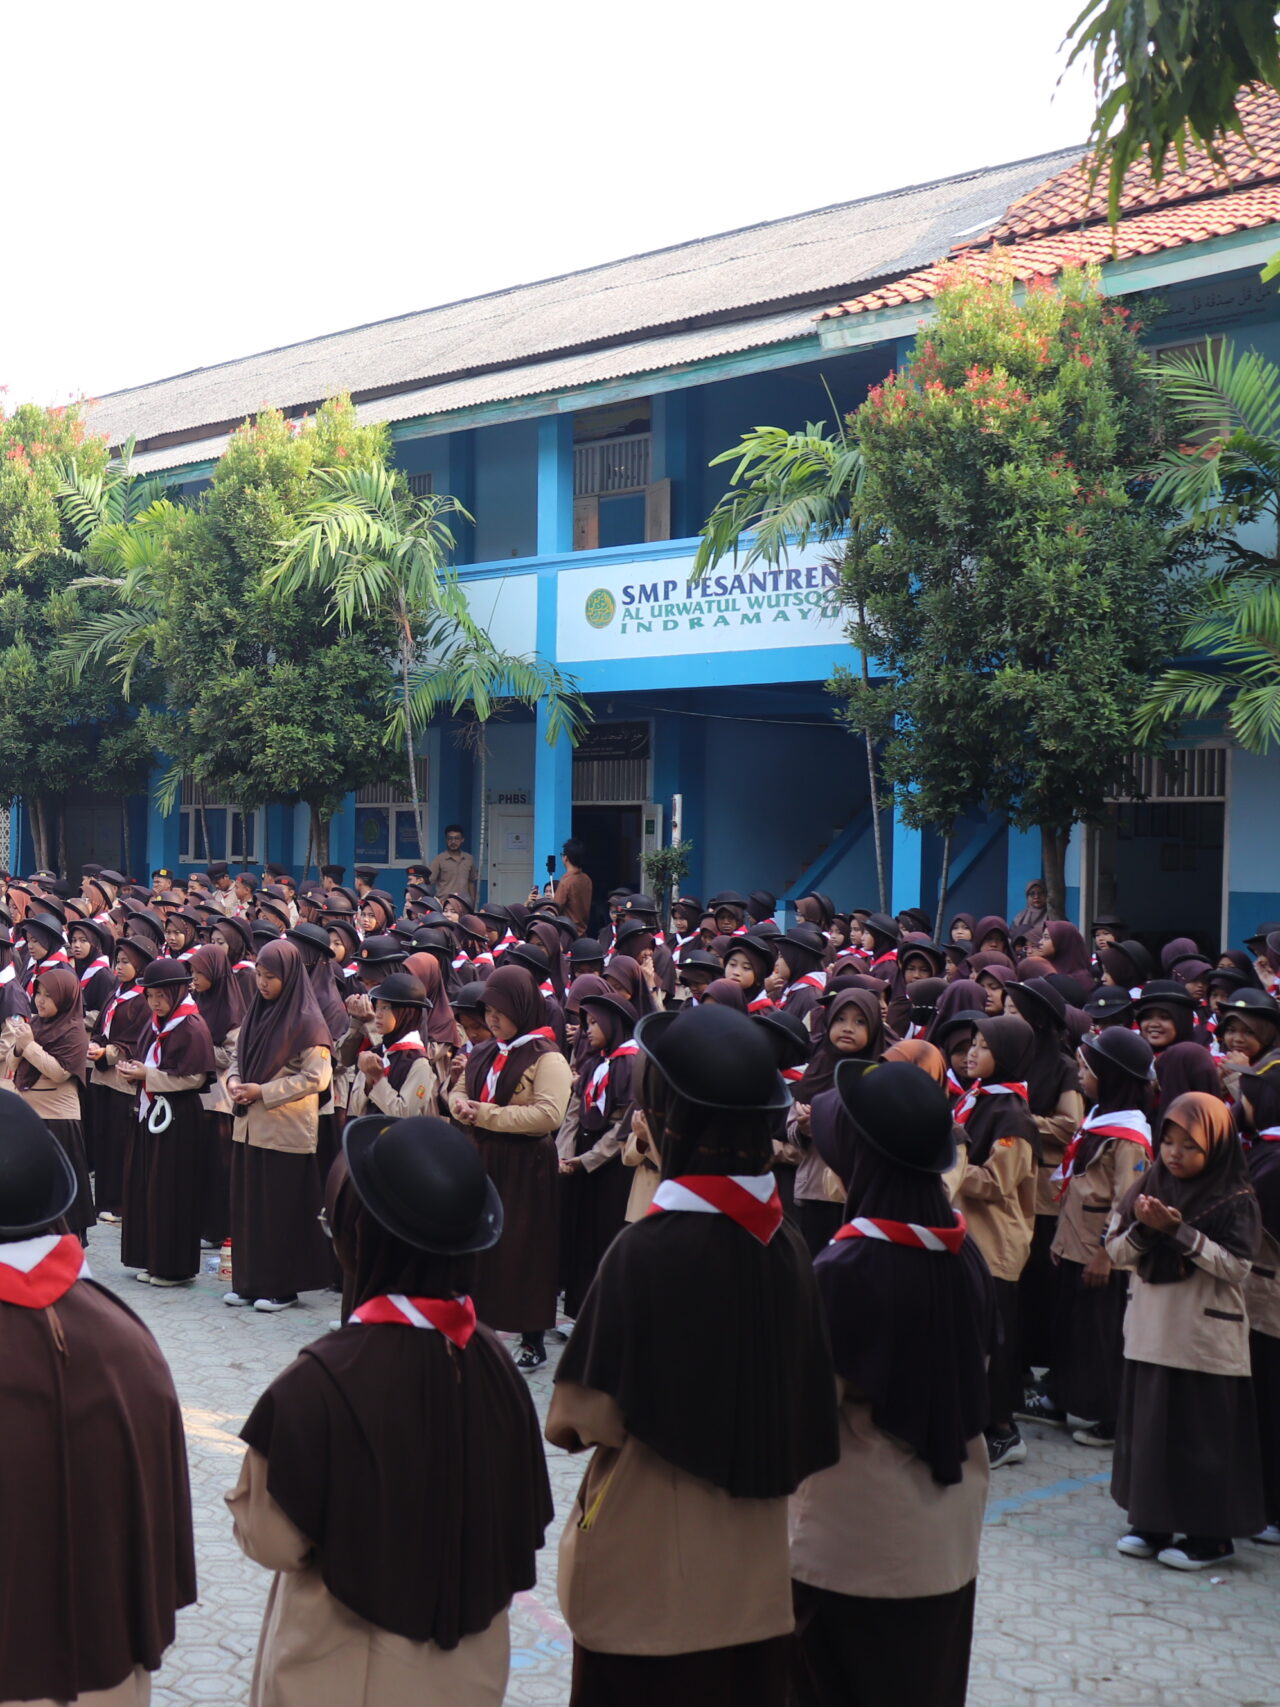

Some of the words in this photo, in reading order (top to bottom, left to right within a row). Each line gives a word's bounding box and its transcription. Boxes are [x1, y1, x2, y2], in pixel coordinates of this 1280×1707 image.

[621, 579, 677, 606] SMP
[686, 564, 840, 599] PESANTREN
[621, 606, 840, 634] INDRAMAYU
[622, 606, 644, 621] AL
[650, 598, 741, 619] URWATUL
[498, 794, 527, 805] PHBS
